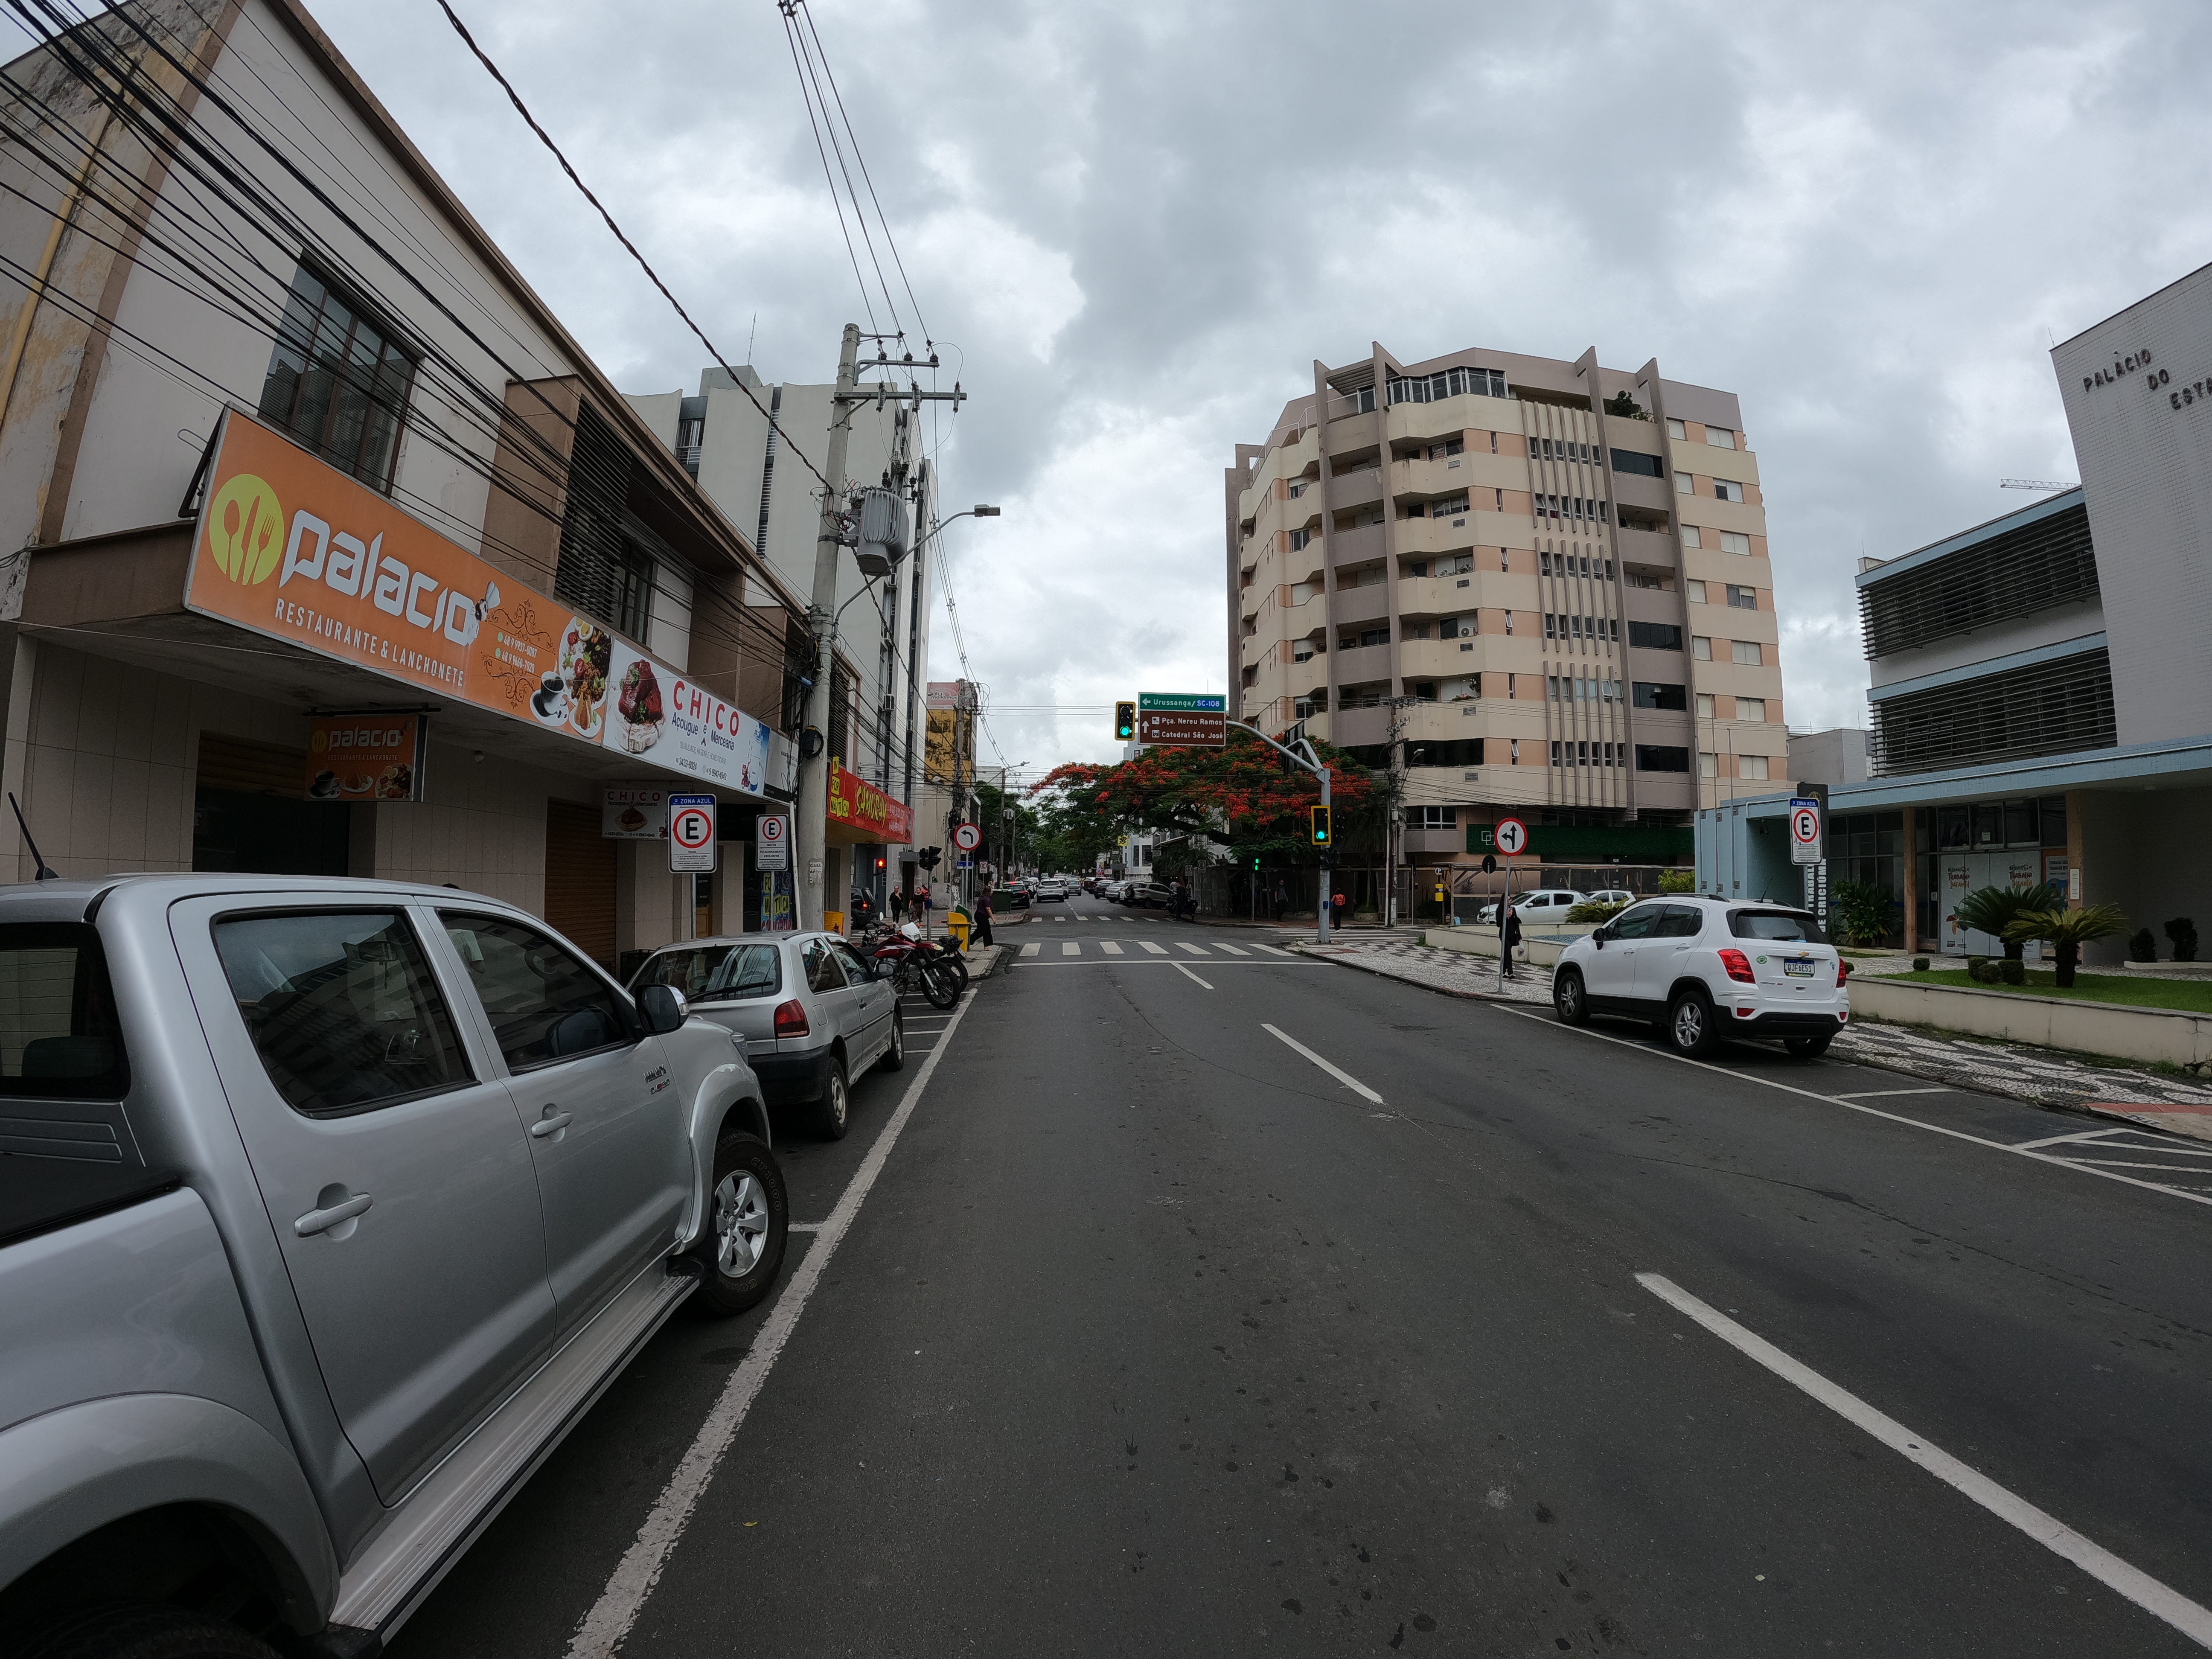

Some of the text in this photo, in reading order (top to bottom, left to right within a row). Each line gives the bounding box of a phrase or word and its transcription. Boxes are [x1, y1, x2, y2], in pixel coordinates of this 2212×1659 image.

[2083, 348, 2151, 392] PALÁCIO
[2147, 369, 2169, 390] DO
[275, 598, 465, 687] RESTAURANTE & LANCHONETE
[504, 635, 537, 658] 48 9 9937-0087
[501, 650, 535, 673] 48 9 9660-7020
[673, 681, 739, 736] CHICO
[671, 712, 735, 751] Açougue e Mercearia
[607, 791, 661, 801] CHICO
[686, 818, 699, 840] E
[768, 823, 775, 835] E
[1801, 817, 1810, 835] E
[1817, 859, 1827, 916] CRICIÚMA
[1788, 964, 1811, 972] QJF6E51
